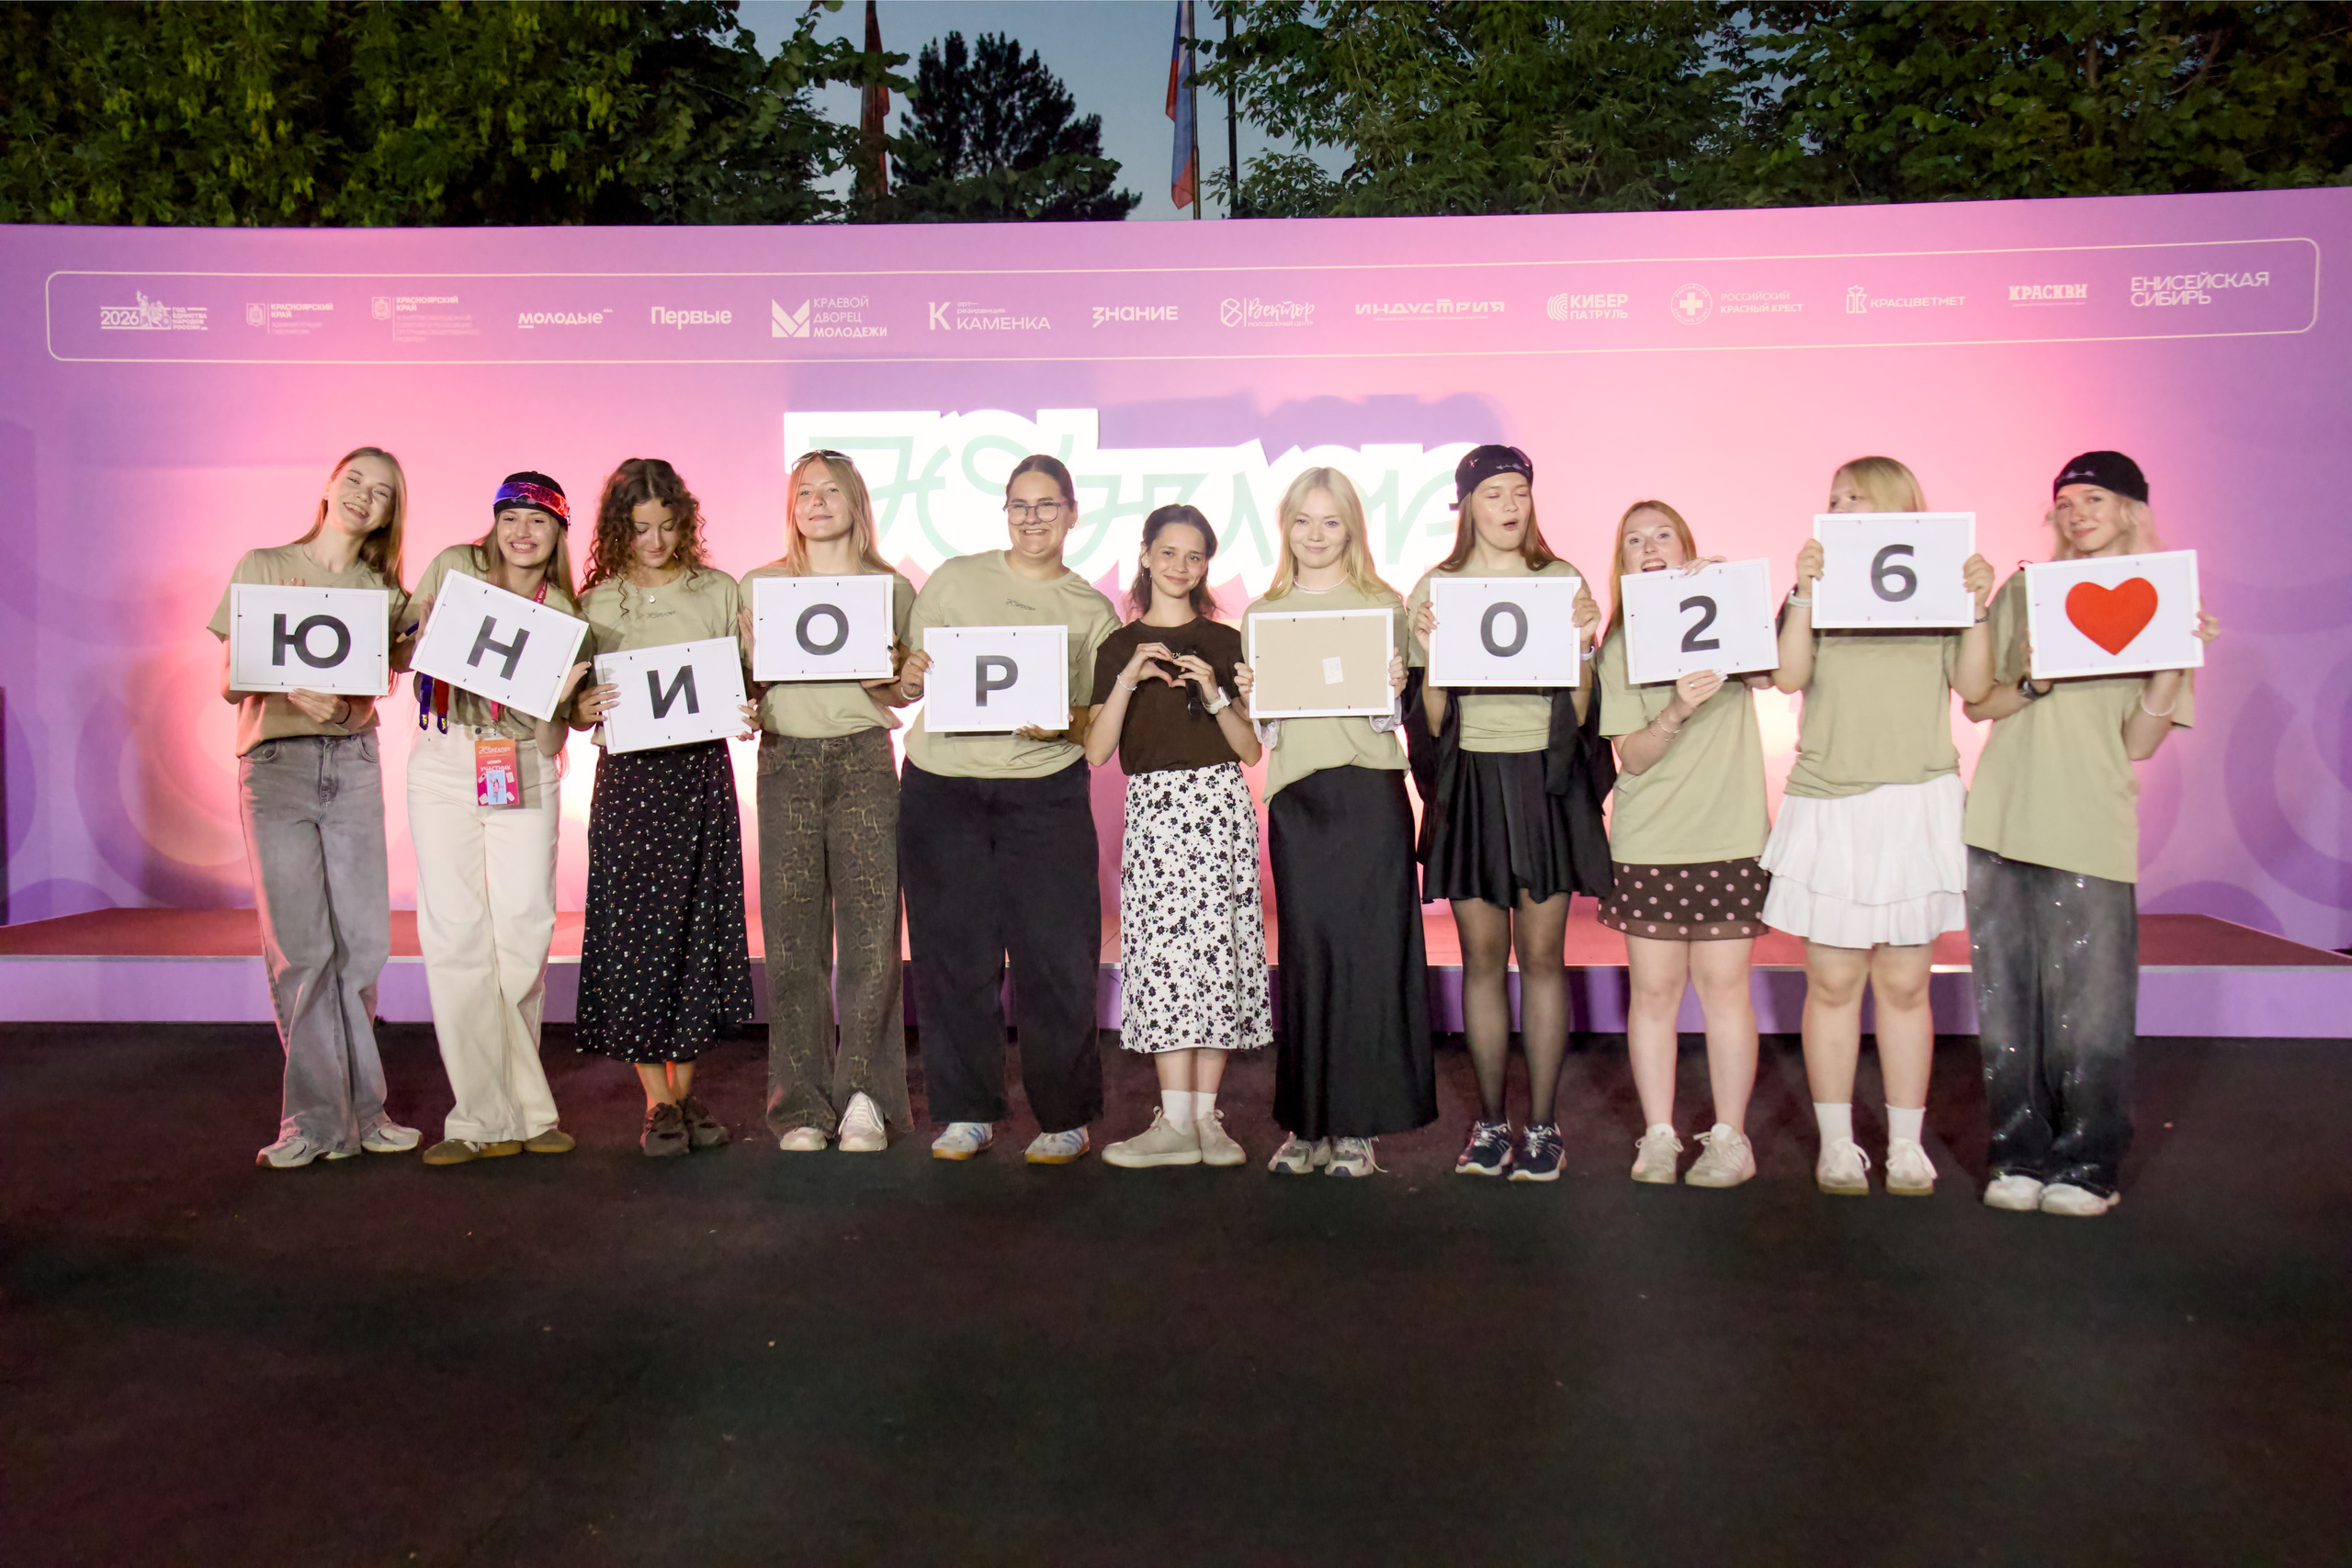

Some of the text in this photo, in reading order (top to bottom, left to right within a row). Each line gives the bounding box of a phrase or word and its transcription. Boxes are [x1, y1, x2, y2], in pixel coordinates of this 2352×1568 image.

[2131, 271, 2270, 292] ЕНИСЕЙСКАЯ
[396, 295, 459, 304] КРАСНОЯРСКИЙ
[1720, 290, 1791, 301] РОССИЙСКИЙ
[2008, 284, 2087, 300] КРАСКВН
[2131, 290, 2212, 307] СИБИРЬ
[396, 303, 417, 311] КРАЙ
[813, 295, 869, 309] КРАЕВОЙ
[1355, 299, 1505, 314] ИНДУСТРИЯ
[1569, 293, 1628, 309] КИБЕР
[1720, 303, 1804, 314] КРАСНЫЙ КРЕСТ
[1870, 296, 1966, 310] КРАСЦВЕТМЕТ
[270, 310, 292, 319] КРАЙ
[1248, 297, 1315, 321] Вектор
[1570, 309, 1629, 320] ПАТРУЛЬ
[100, 310, 140, 326] 2026
[517, 311, 604, 326] молодые
[650, 306, 732, 330] Первые
[813, 311, 862, 323] ДВОРЕЦ
[956, 317, 1051, 331] КАМЕНКА
[813, 326, 888, 338] МОЛОДЕЖИ
[1870, 542, 1918, 603] 6
[1679, 594, 1721, 654] 2
[271, 612, 351, 669] Ю
[466, 615, 531, 681] Н
[975, 655, 1019, 707] Р
[646, 664, 700, 719] И
